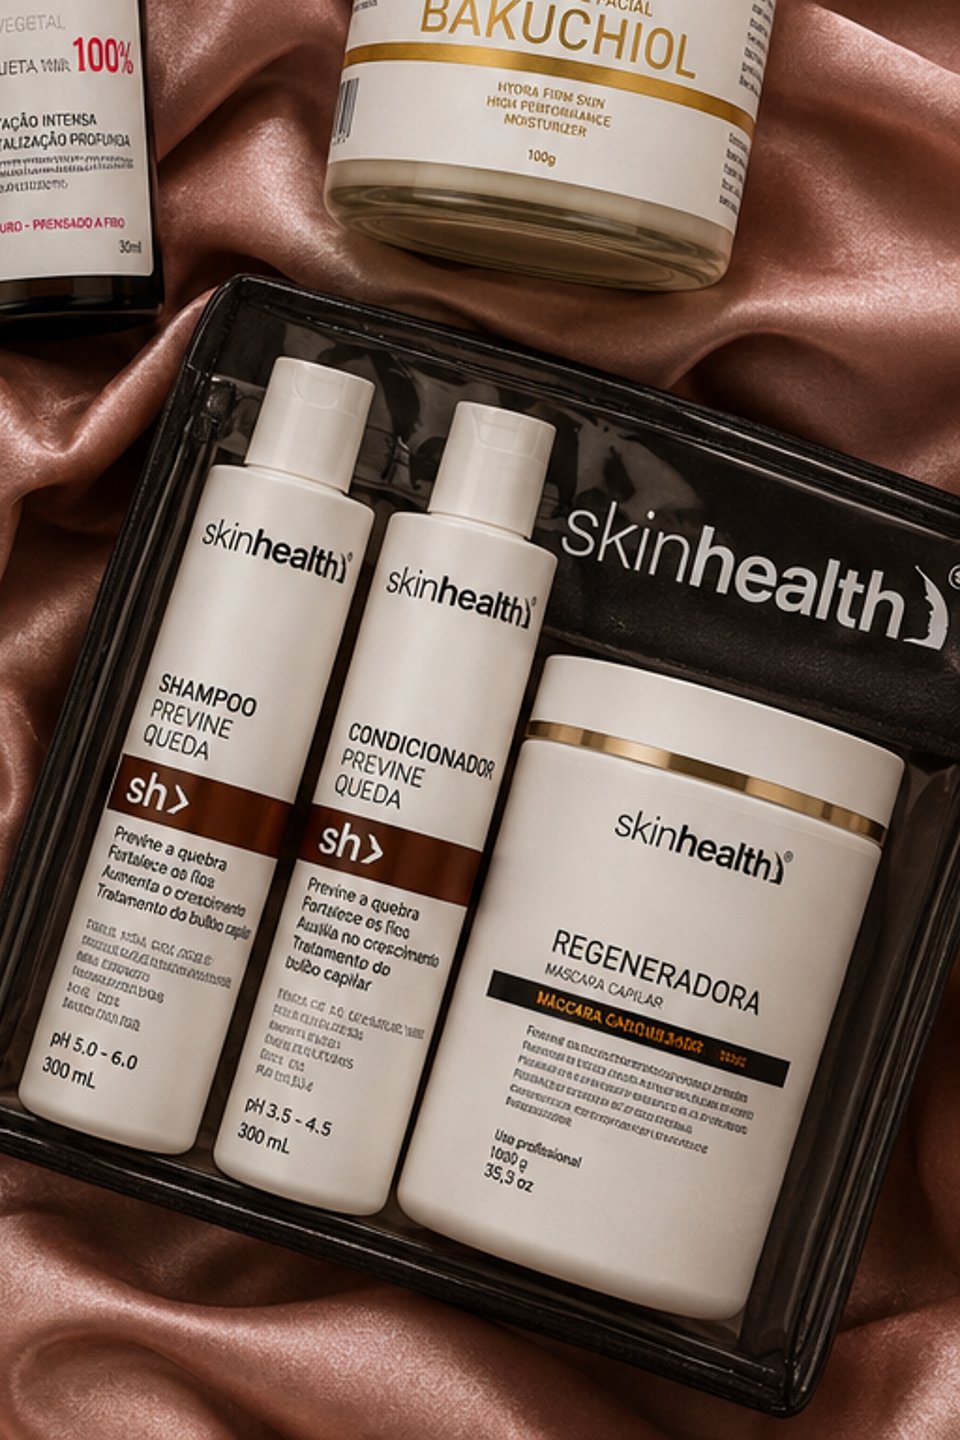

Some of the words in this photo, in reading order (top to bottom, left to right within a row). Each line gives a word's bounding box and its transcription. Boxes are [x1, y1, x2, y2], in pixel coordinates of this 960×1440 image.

[73, 37, 134, 74] 100%
[561, 500, 905, 640] skinhealth
[159, 672, 258, 718] SHAMPOO
[151, 699, 234, 740] PREVINE
[143, 723, 210, 761] QUEDA
[348, 723, 495, 780] CONDICIONADOR
[341, 748, 426, 788] PREVINE
[334, 774, 401, 809] QUEDA
[165, 845, 175, 856] a
[178, 848, 227, 872] quebra
[163, 885, 172, 896] o
[359, 895, 368, 906] a
[371, 898, 420, 921] quebra
[170, 906, 187, 921] do
[341, 933, 360, 946] no
[372, 962, 391, 976] do
[551, 929, 761, 1017] REGENERADORA
[50, 1032, 71, 1048] pH
[73, 1037, 98, 1056] 5.0
[111, 1050, 138, 1069] 6.0
[42, 1056, 70, 1078] 300
[71, 1070, 95, 1089] mL
[245, 1098, 266, 1115] pH
[266, 1103, 293, 1124] 3.5
[305, 1117, 332, 1136] 4.5
[237, 1121, 265, 1144] 300
[266, 1136, 289, 1155] mL
[517, 1178, 534, 1193] oz
